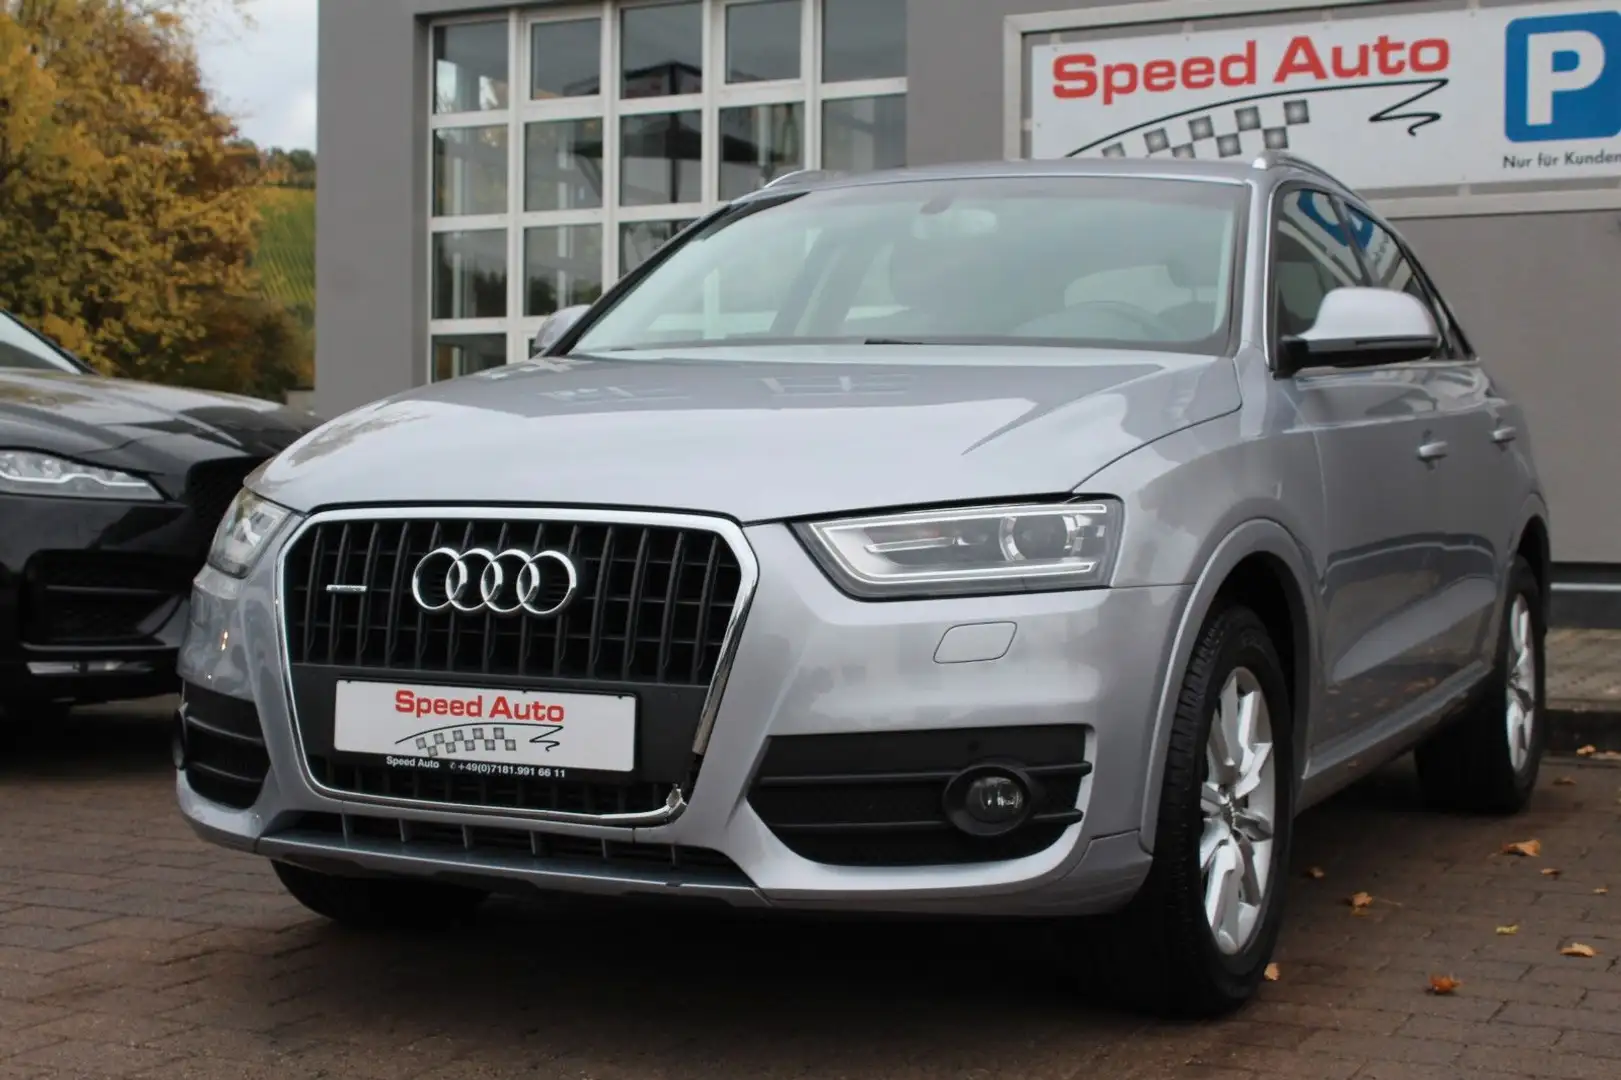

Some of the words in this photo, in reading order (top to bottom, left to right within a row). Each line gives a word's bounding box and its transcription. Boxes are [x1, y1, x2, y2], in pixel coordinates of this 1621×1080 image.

[1052, 39, 1258, 106] Speed
[1272, 35, 1451, 85] Auto
[1527, 30, 1605, 125] P
[1503, 155, 1533, 169] Nur
[1537, 152, 1559, 167] für
[394, 688, 484, 718] Speed
[488, 695, 566, 723] Auto
[386, 755, 416, 767] Speed
[417, 758, 440, 769] Auto
[537, 765, 551, 777] 66
[554, 767, 566, 778] 11
